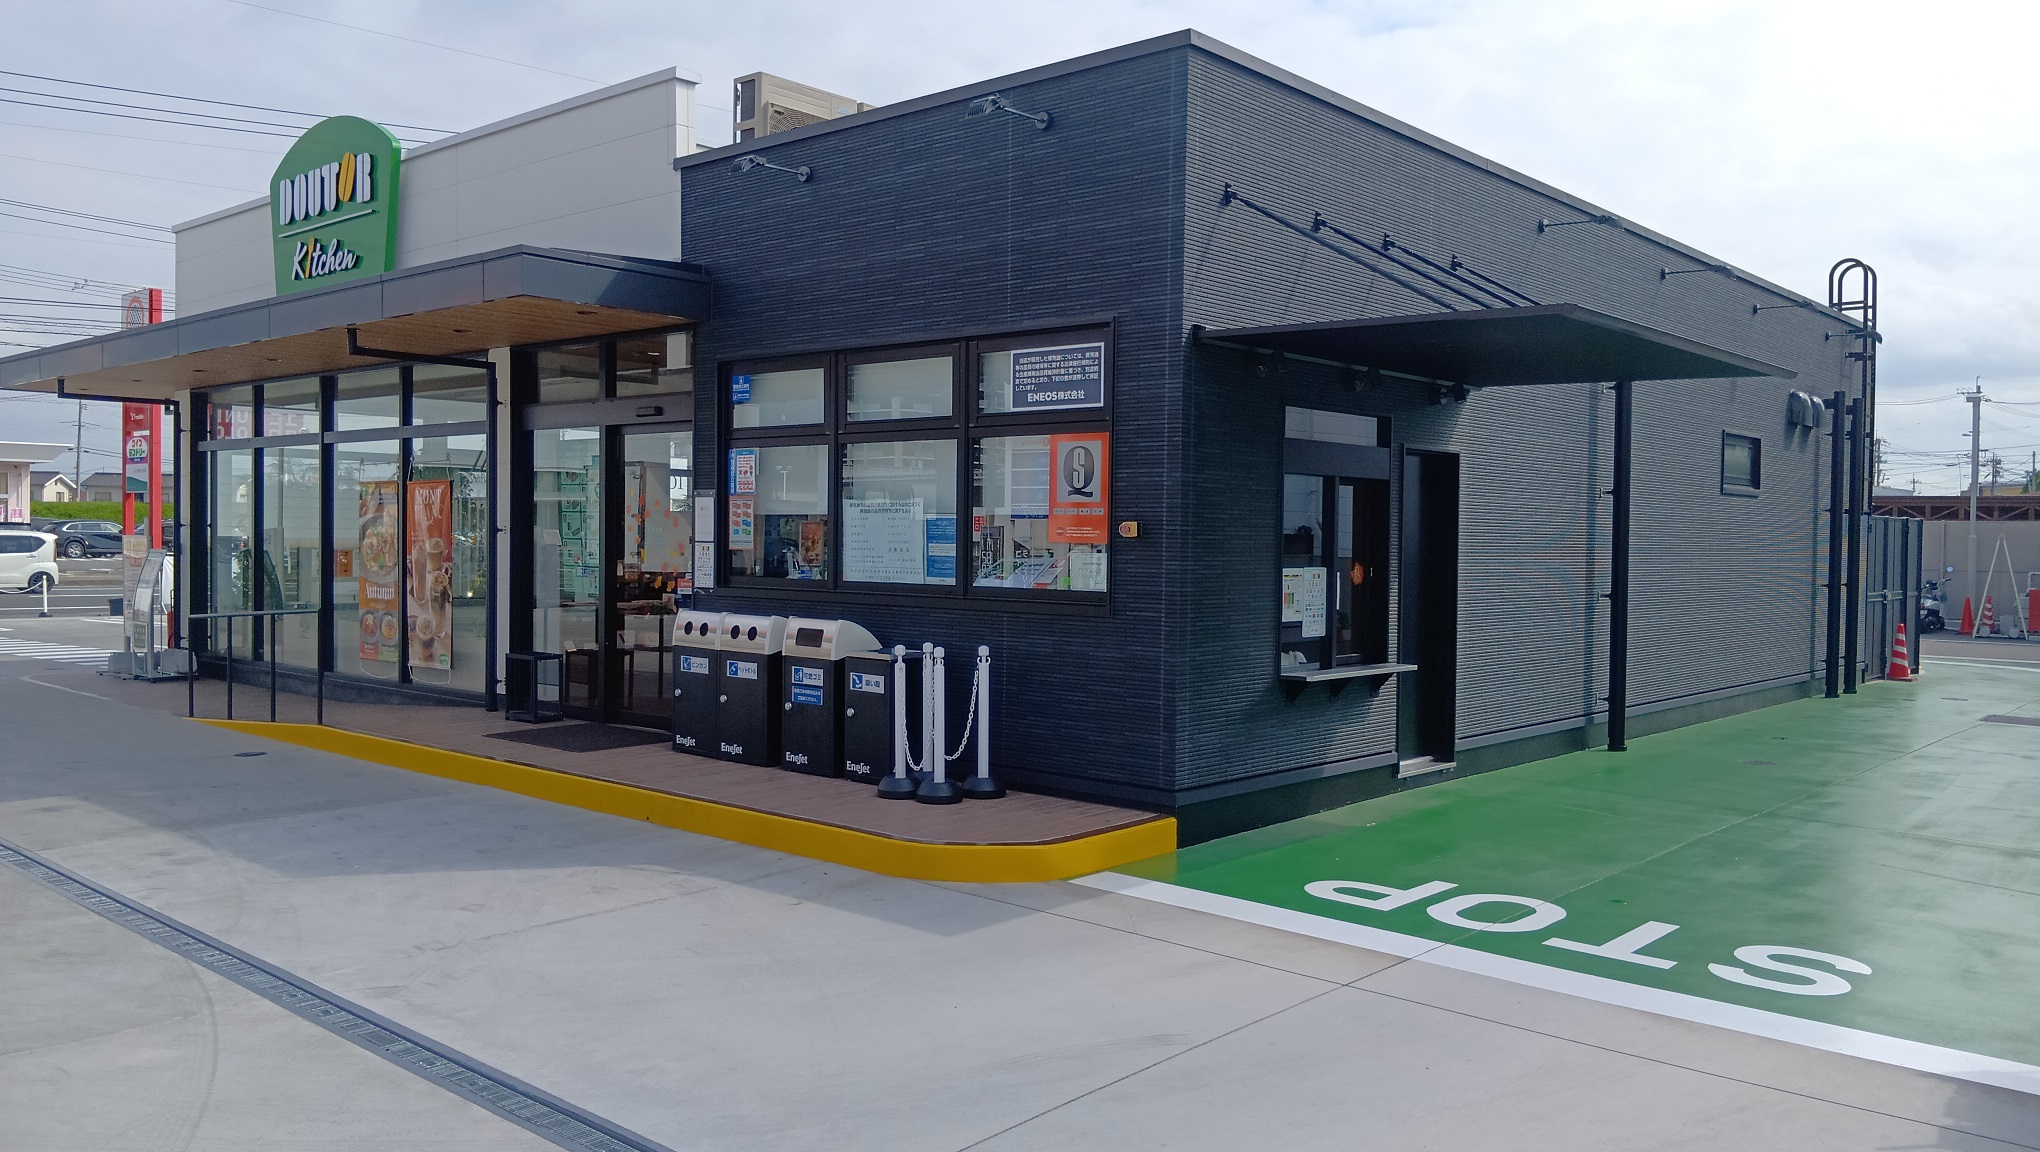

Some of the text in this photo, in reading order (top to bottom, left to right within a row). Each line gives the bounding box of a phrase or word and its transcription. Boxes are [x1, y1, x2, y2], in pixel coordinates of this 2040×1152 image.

[279, 152, 372, 225] DOUTOR
[292, 237, 357, 280] Kitchen
[365, 584, 395, 600] Autumn
[676, 735, 696, 747] EneJet
[721, 743, 743, 756] EneJet
[786, 752, 808, 765] EneJet
[846, 761, 871, 774] EneJet
[1304, 880, 1873, 997] STOP
